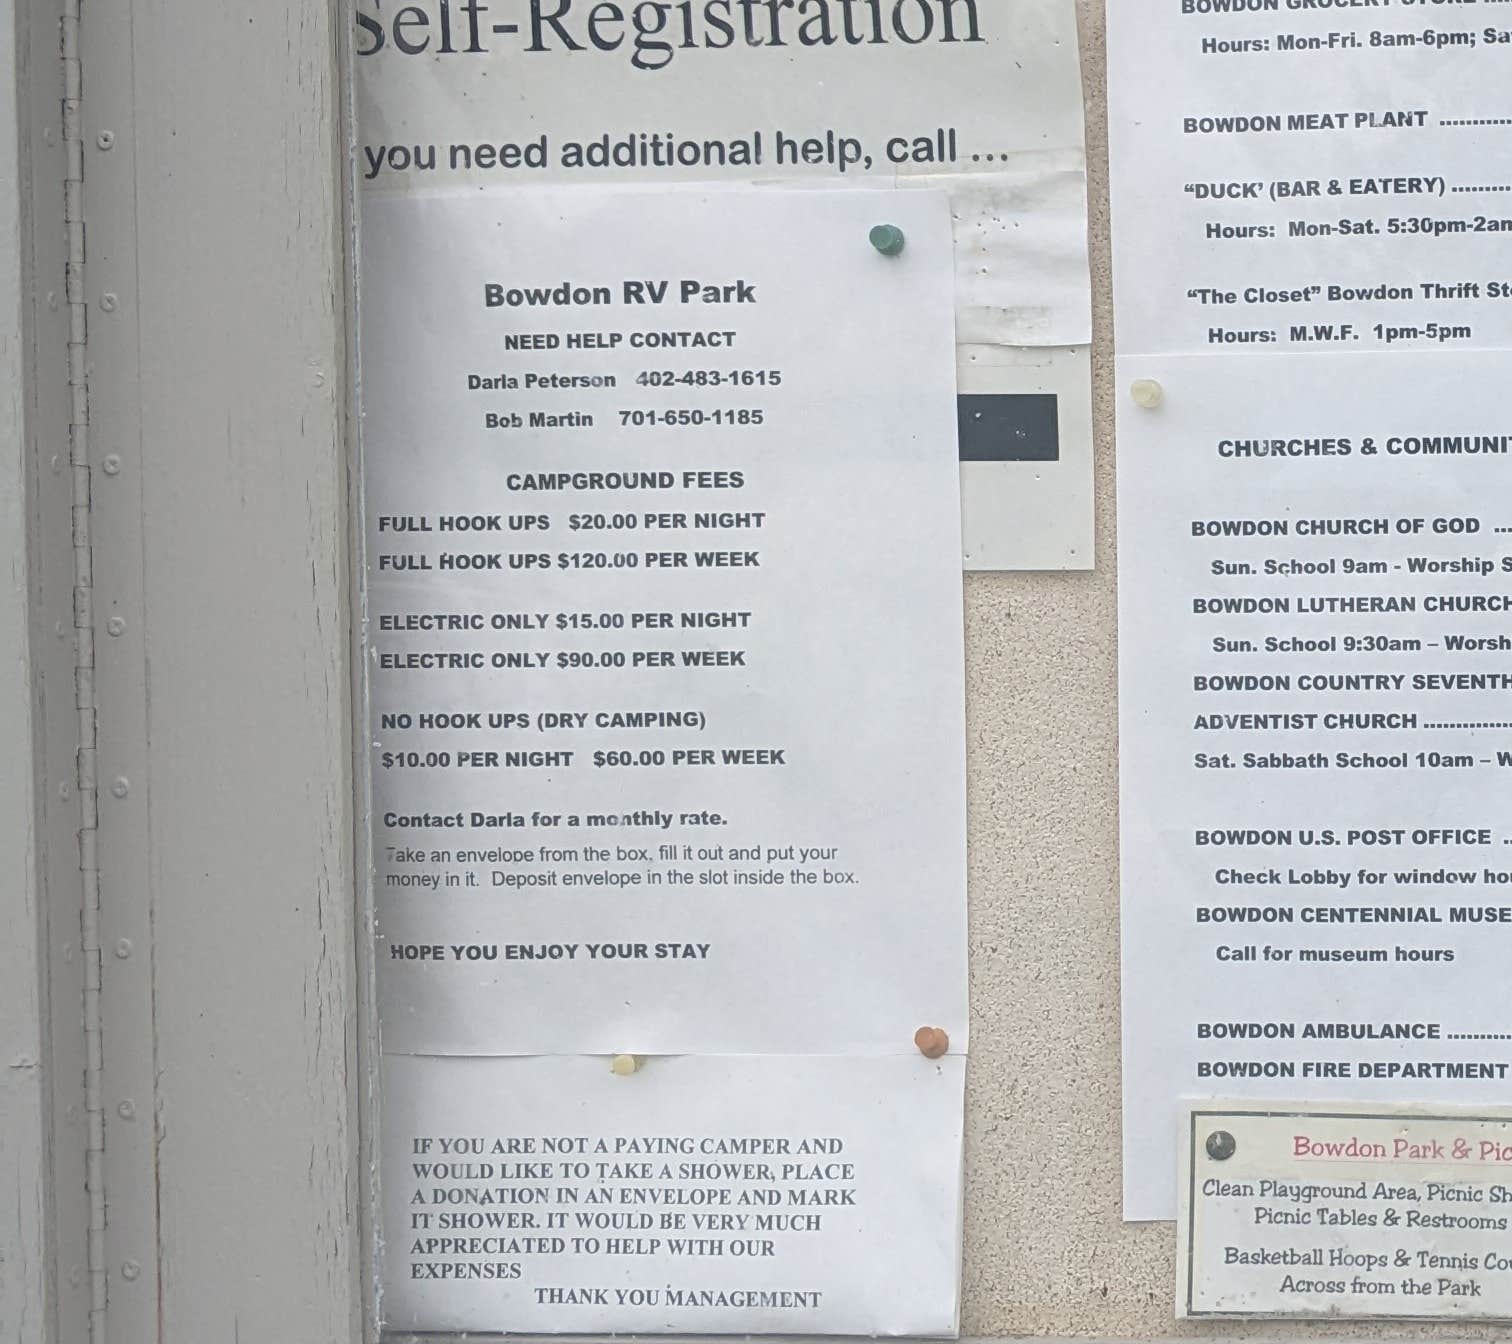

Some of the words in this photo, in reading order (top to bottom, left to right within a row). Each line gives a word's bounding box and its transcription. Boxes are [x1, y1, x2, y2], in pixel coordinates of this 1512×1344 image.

[364, 144, 435, 179] you
[449, 134, 547, 170] need
[560, 130, 761, 167] additional
[775, 129, 872, 173] help,
[886, 127, 956, 163] call
[484, 281, 610, 307] Bowdon
[623, 280, 668, 304] RV
[680, 279, 756, 303] Park
[504, 333, 560, 350] NEED
[566, 332, 622, 349] HELP
[629, 331, 736, 348] CONTACT
[467, 373, 518, 390] Darla
[524, 372, 616, 388] Peterson
[636, 369, 781, 387] 402-483-1615
[485, 412, 523, 428] Bob
[529, 411, 593, 427] Martin
[618, 408, 763, 426] 701-650-1185
[1218, 438, 1351, 457] CHURCHES
[1360, 437, 1377, 455] &
[506, 471, 674, 491] CAMPGROUND
[682, 471, 744, 488] FEES
[379, 516, 432, 532] FULL
[439, 515, 501, 531] HOOK
[508, 514, 550, 531] UPS
[568, 513, 637, 531] $20.00
[644, 513, 687, 529] PER
[694, 512, 765, 528] NIGHT
[1211, 559, 1256, 575] Sun.
[1263, 558, 1335, 577] School
[1342, 558, 1387, 574] 9am
[1406, 556, 1494, 576] Worship
[1193, 675, 1290, 691] BOWDON
[1297, 674, 1405, 691] COUNTRY
[413, 1138, 433, 1154] IF
[438, 1137, 484, 1154] YOU
[490, 1137, 536, 1154] ARE
[541, 1137, 588, 1154] NOT
[593, 1137, 608, 1153] A
[614, 1137, 694, 1154] PAYING
[699, 1137, 790, 1155] CAMPER
[796, 1137, 843, 1154] AND
[1293, 1135, 1387, 1158] Bowdon
[1393, 1138, 1444, 1160] Park
[1451, 1137, 1472, 1159] &
[1202, 1178, 1254, 1197] Clean
[1259, 1179, 1367, 1204] Playground
[1372, 1181, 1422, 1203] Area,
[1427, 1182, 1484, 1203] Picnic
[534, 1287, 608, 1305] THANK
[614, 1288, 659, 1306] YOU
[664, 1288, 823, 1310] MANAGEMENT
